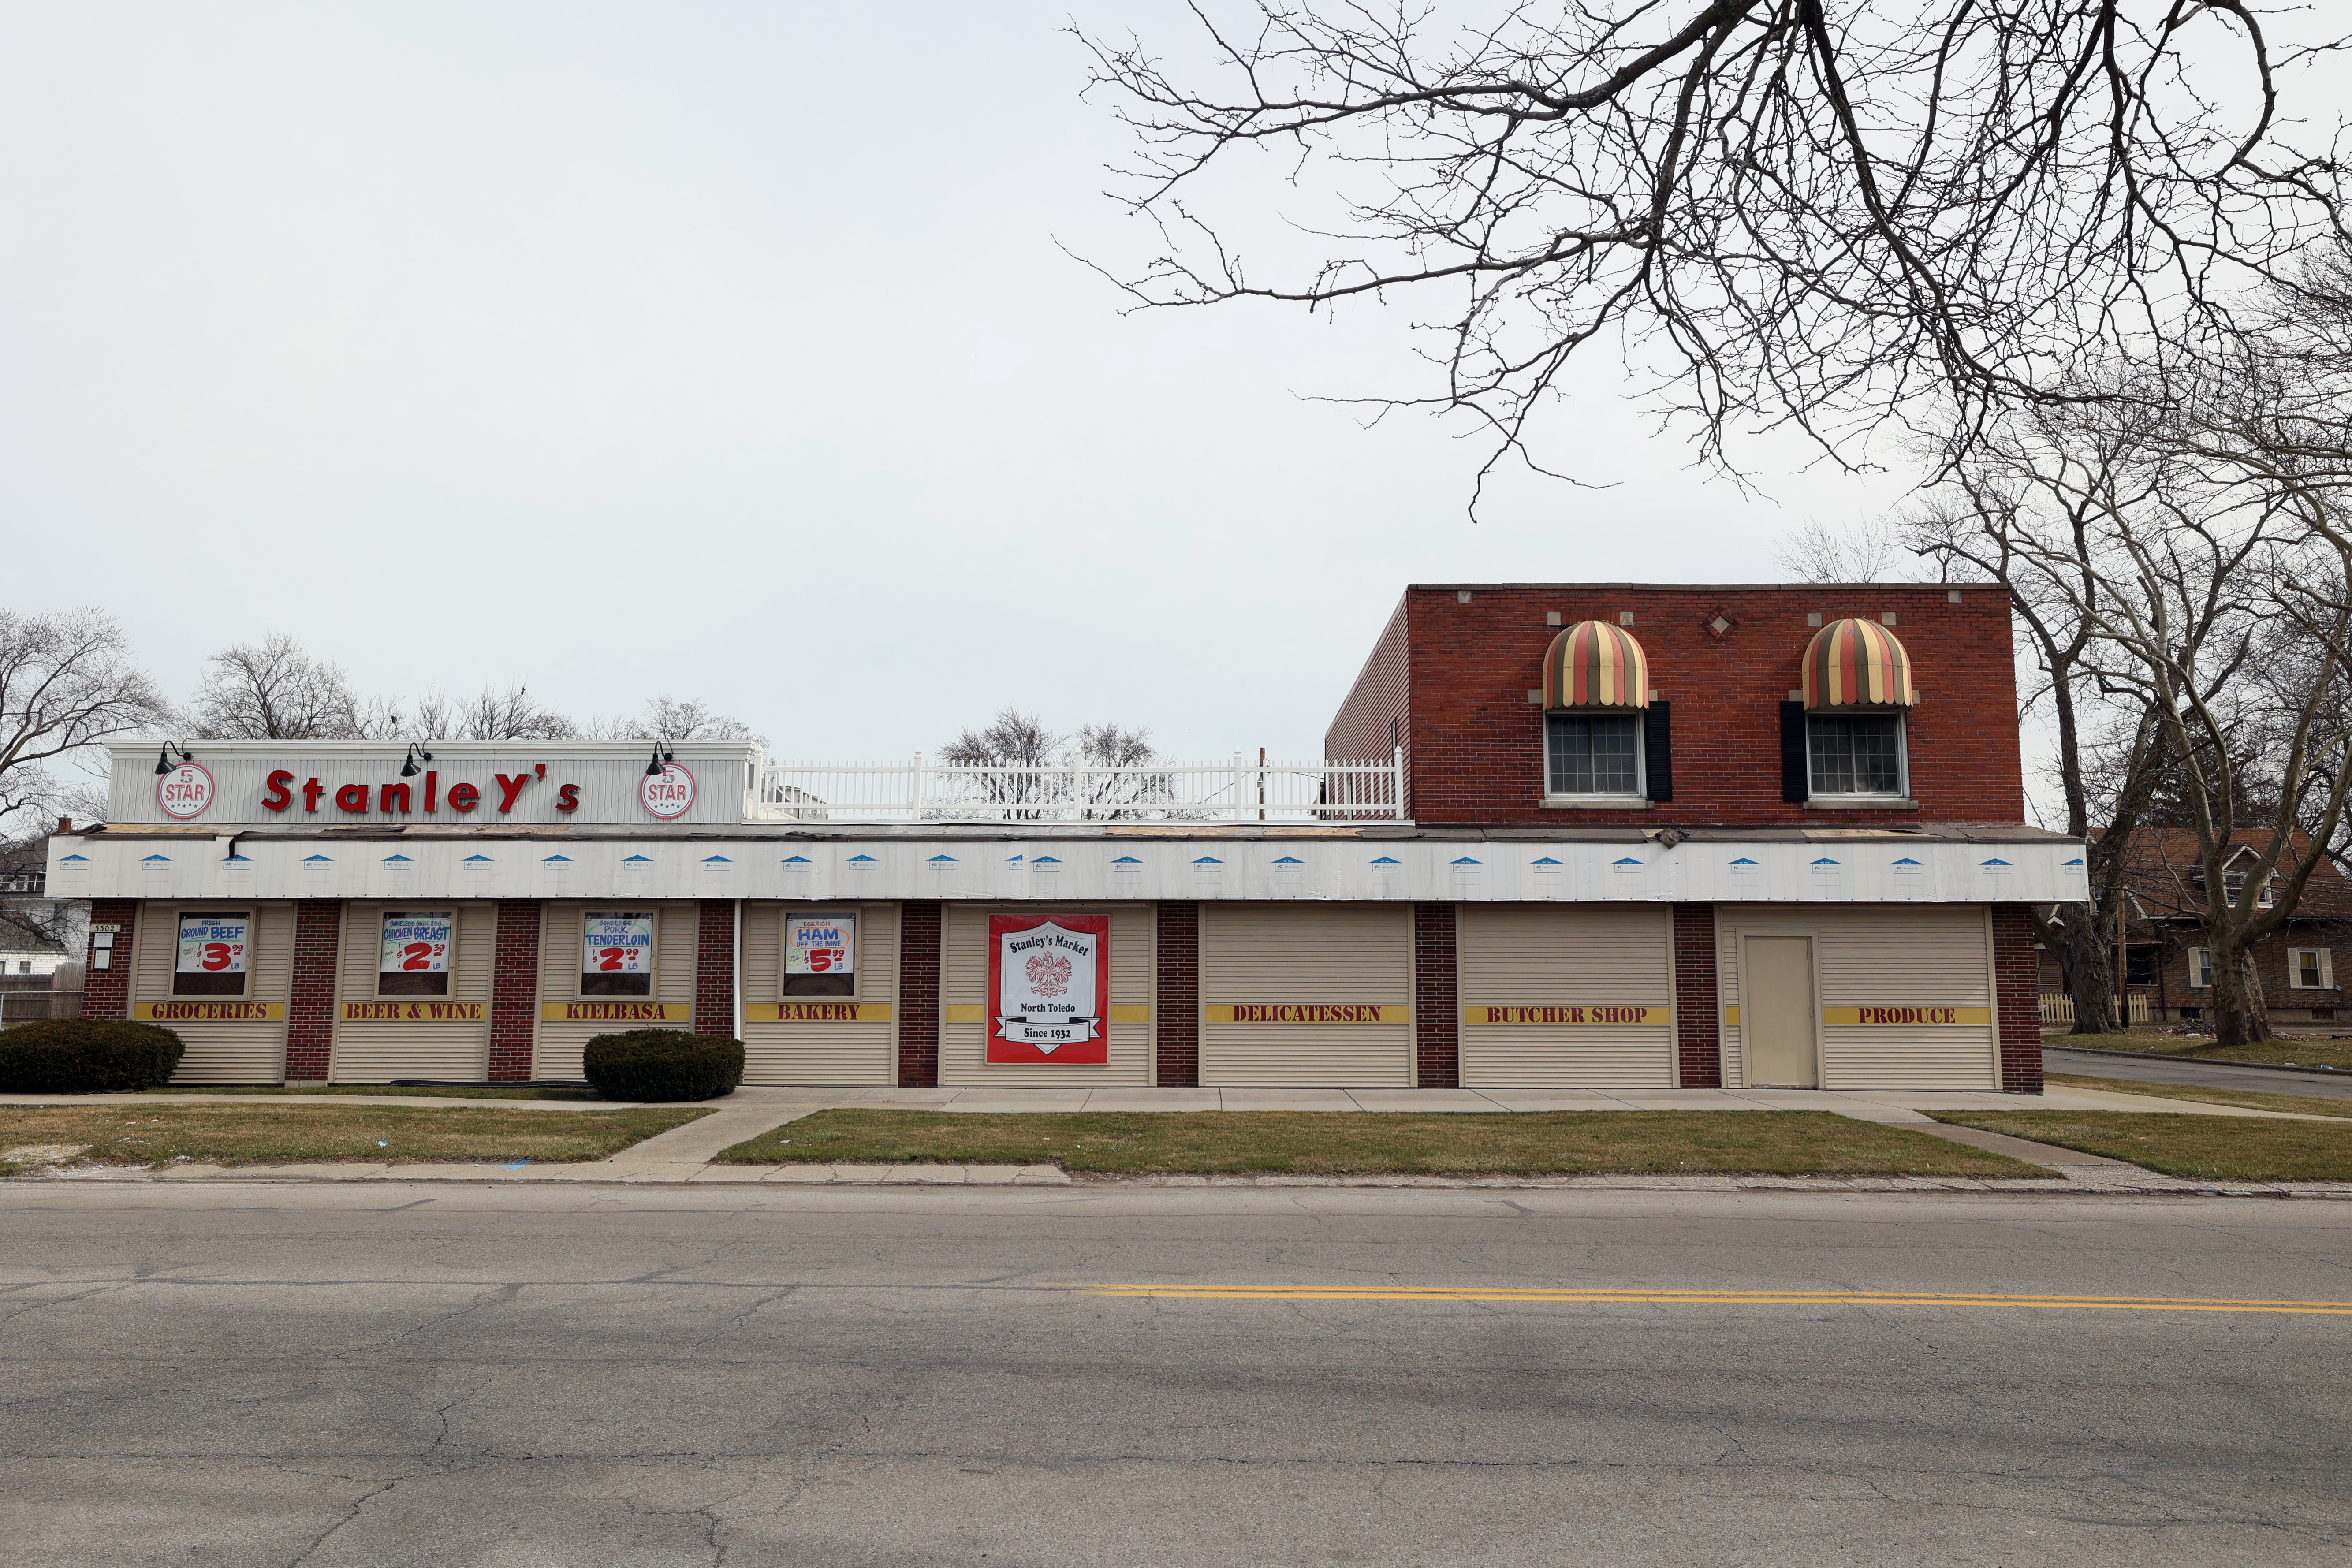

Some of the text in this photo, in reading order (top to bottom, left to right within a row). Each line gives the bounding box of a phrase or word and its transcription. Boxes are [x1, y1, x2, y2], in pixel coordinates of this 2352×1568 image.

[180, 770, 193, 783] 5
[662, 770, 675, 783] 5
[165, 784, 205, 801] STAR
[648, 784, 686, 801] STAR
[181, 926, 245, 939] GROUND BEEF
[383, 927, 450, 940] CHICKEN BREAST
[585, 934, 649, 946] TENDERLOIN
[798, 928, 839, 941] HAM
[1010, 935, 1089, 956] Stanley's Market
[151, 1003, 267, 1019] GROCERIES
[346, 1003, 481, 1019] BEER & WINE
[566, 1003, 666, 1020] KIELBASA
[778, 1004, 861, 1021] BAKERY
[1021, 1003, 1075, 1013] North Toledo
[1233, 1005, 1382, 1022] DELICATESSEN
[1487, 1007, 1648, 1023] BUTCHER SHOP
[1858, 1008, 1956, 1024] PRODUCE
[1024, 1028, 1071, 1039] Since 1932
